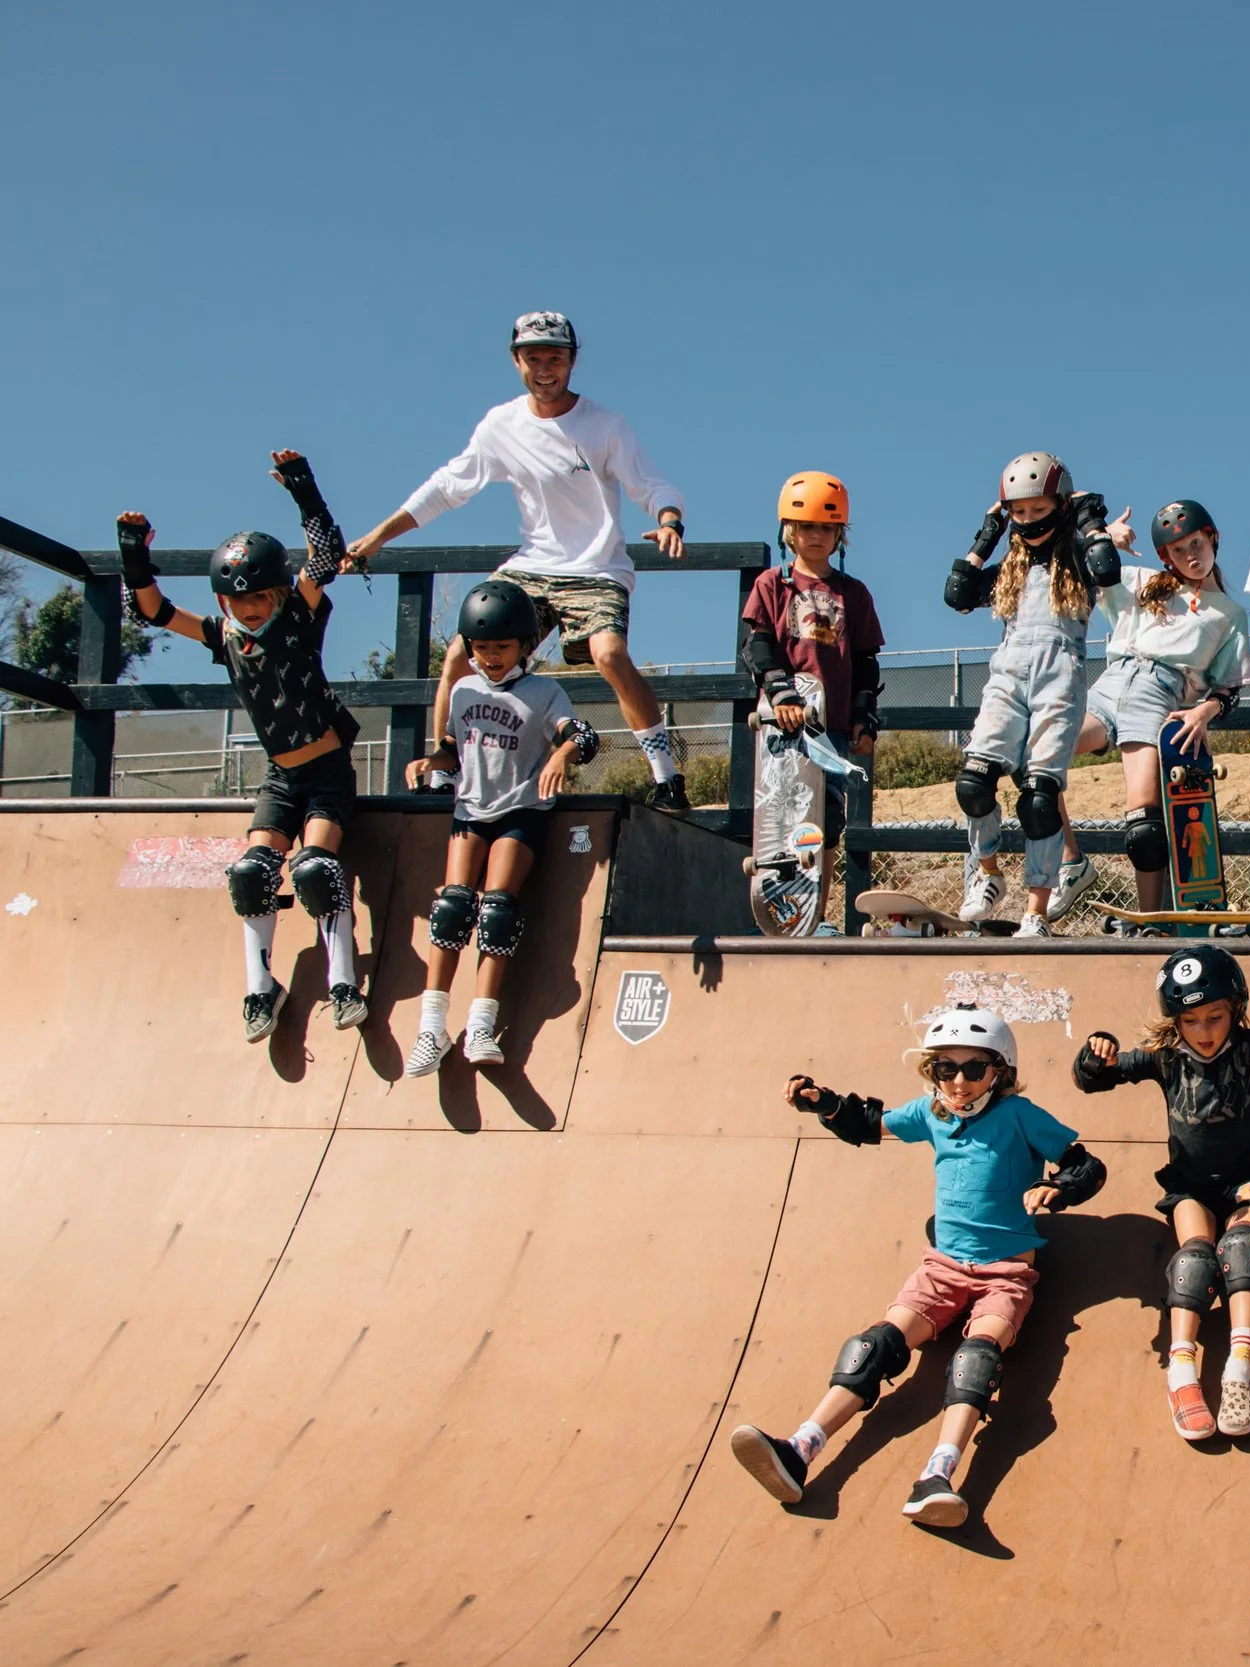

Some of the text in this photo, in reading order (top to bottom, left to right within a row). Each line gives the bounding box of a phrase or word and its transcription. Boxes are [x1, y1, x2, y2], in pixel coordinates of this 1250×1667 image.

[463, 729, 519, 751] AN CLUB
[1181, 963, 1192, 978] 8
[620, 999, 664, 1021] STYLE
